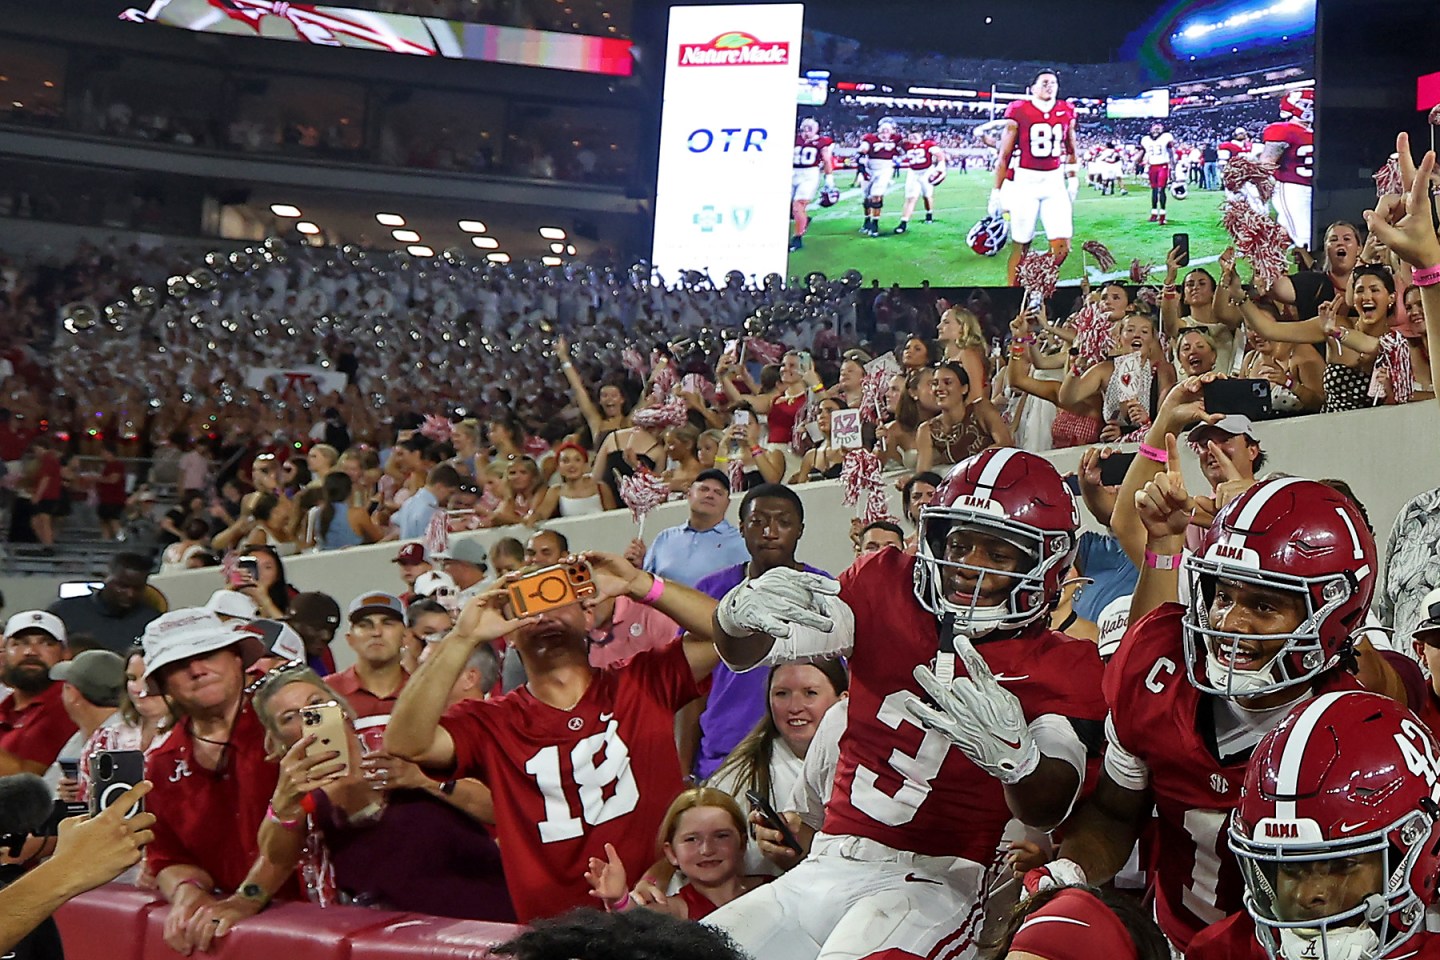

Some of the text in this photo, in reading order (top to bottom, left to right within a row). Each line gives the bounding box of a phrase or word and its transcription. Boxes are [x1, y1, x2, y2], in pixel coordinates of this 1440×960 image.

[687, 127, 768, 154] OTR
[1030, 123, 1064, 157] 81
[964, 496, 991, 511] BAMA
[1216, 544, 1244, 561] BAMA
[1145, 656, 1176, 694] C
[850, 690, 956, 827] 3
[523, 720, 640, 843] 18
[1264, 822, 1299, 838] BAMA
